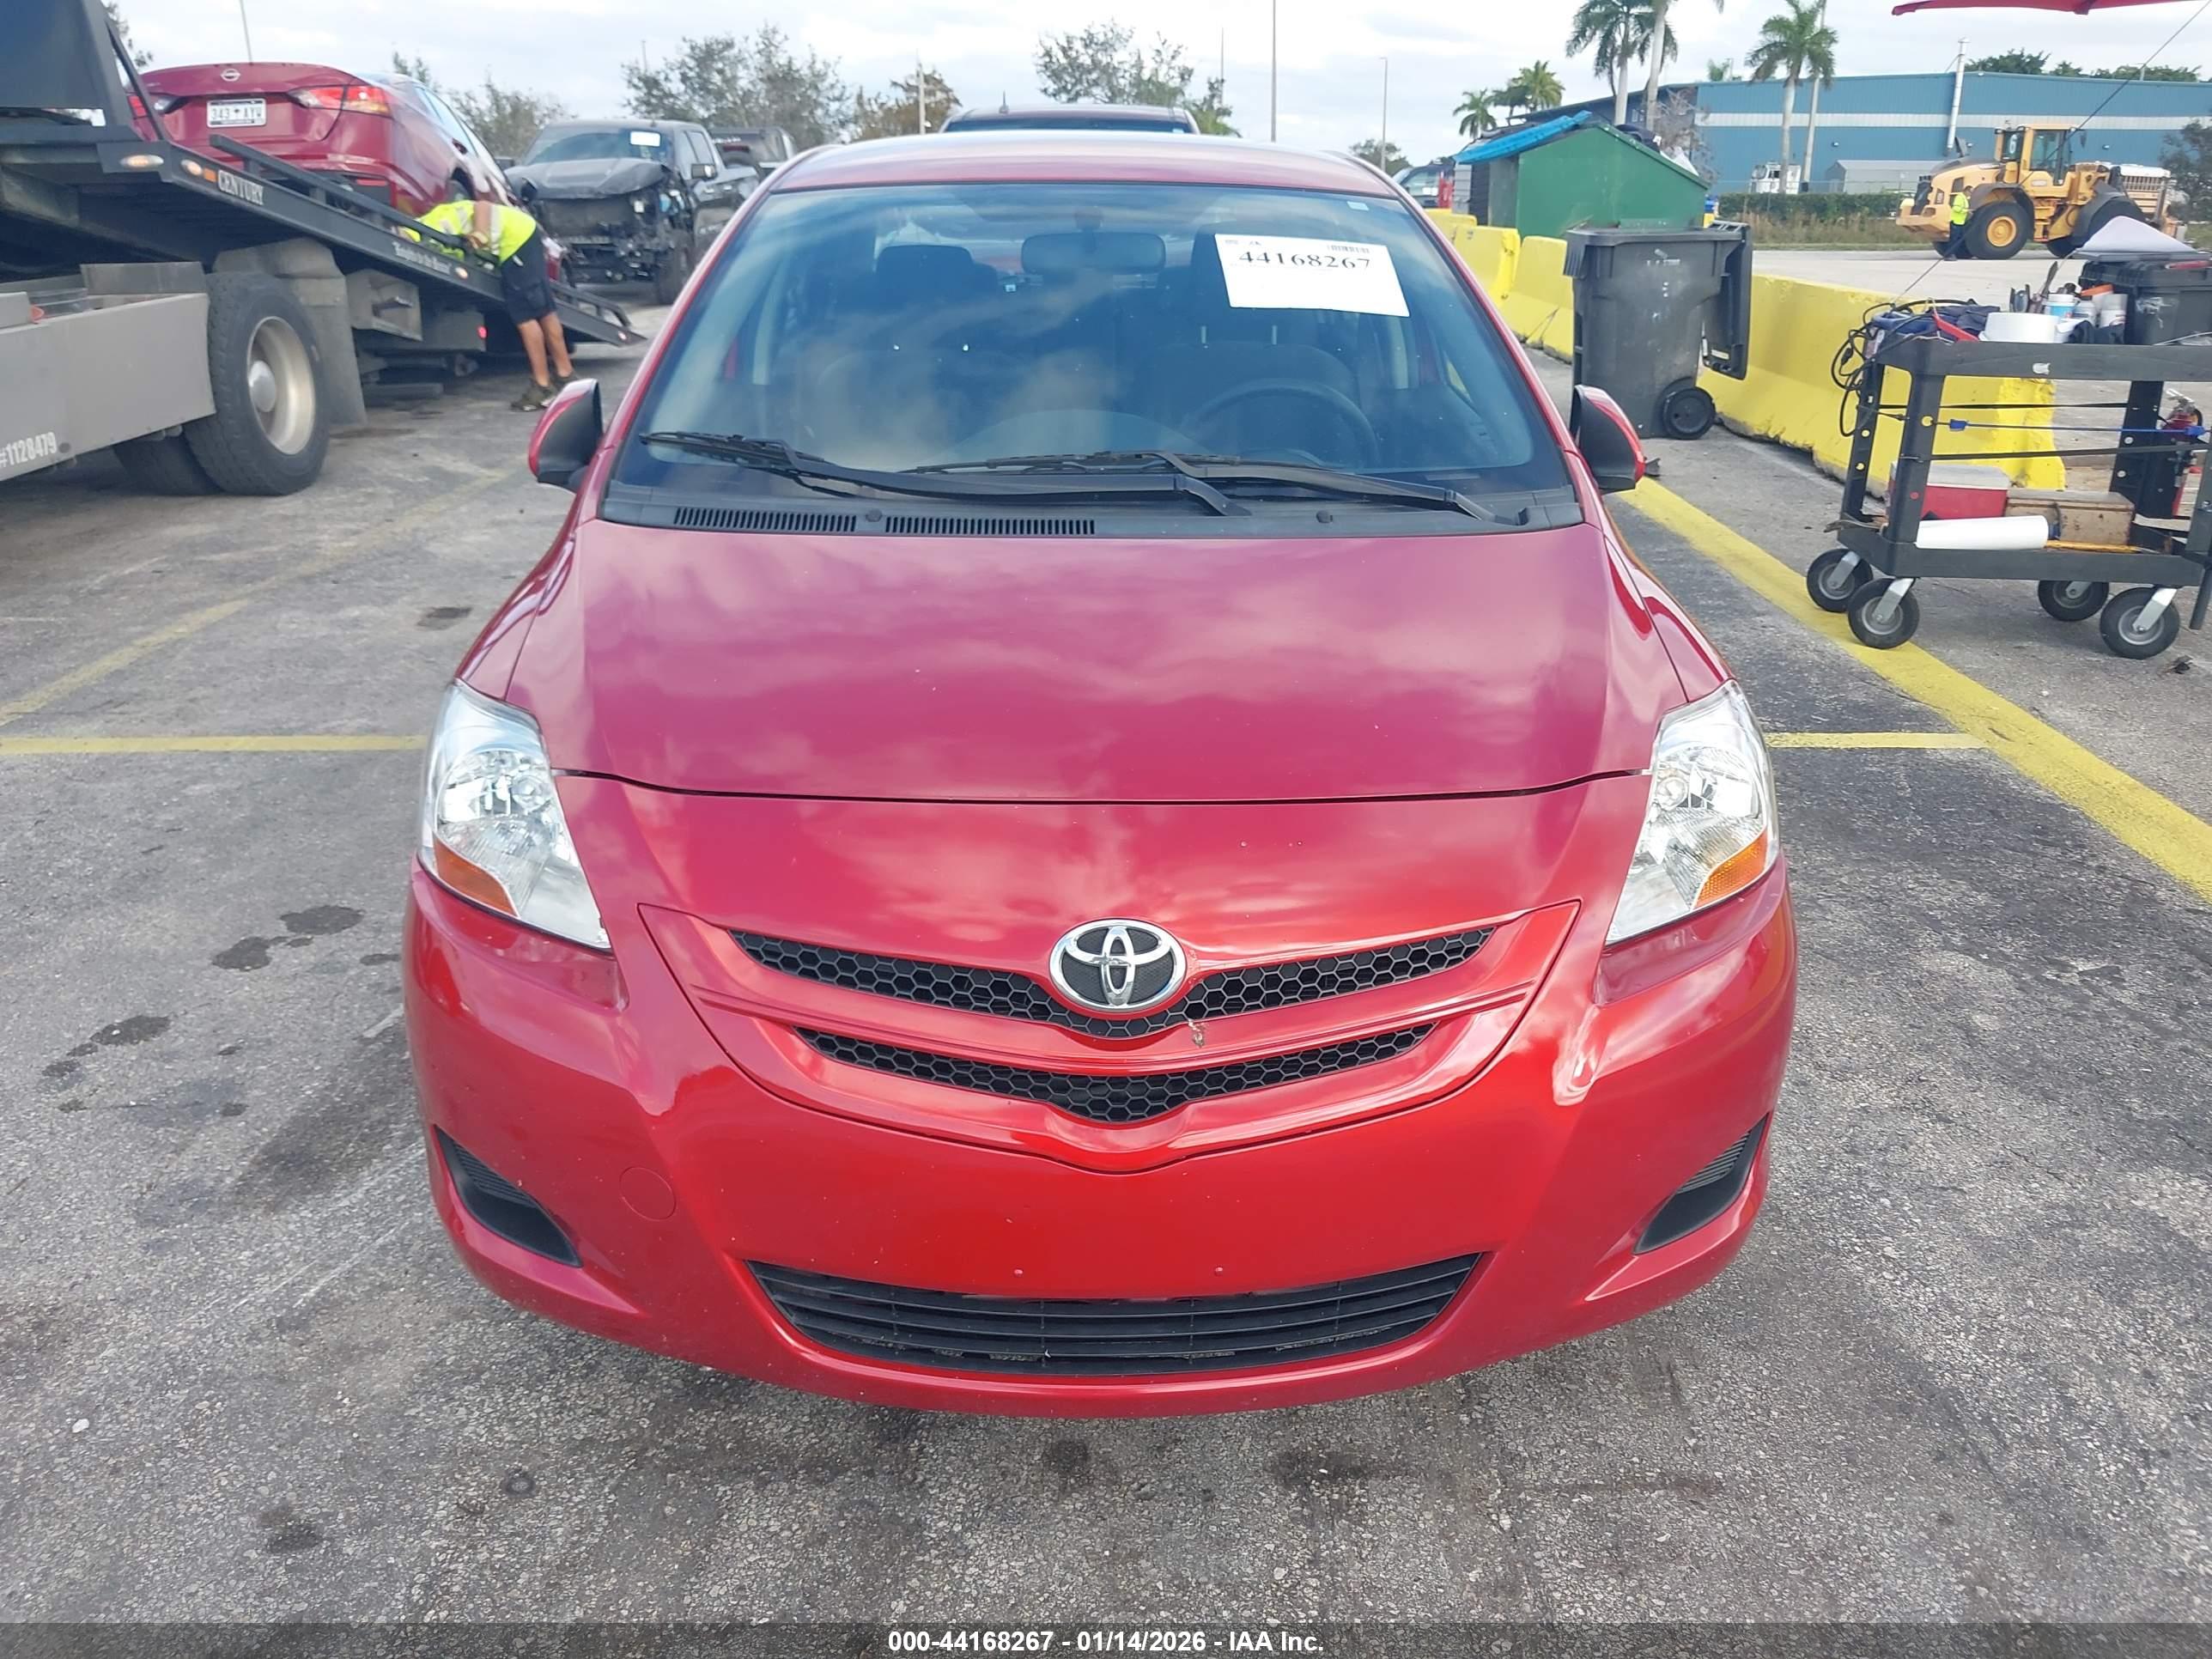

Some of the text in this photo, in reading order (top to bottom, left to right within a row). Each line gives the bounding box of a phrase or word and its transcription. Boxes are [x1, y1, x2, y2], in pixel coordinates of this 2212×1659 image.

[2008, 133, 2018, 155] 6
[218, 169, 264, 205] CENTURY
[1238, 251, 1370, 271] 44168267
